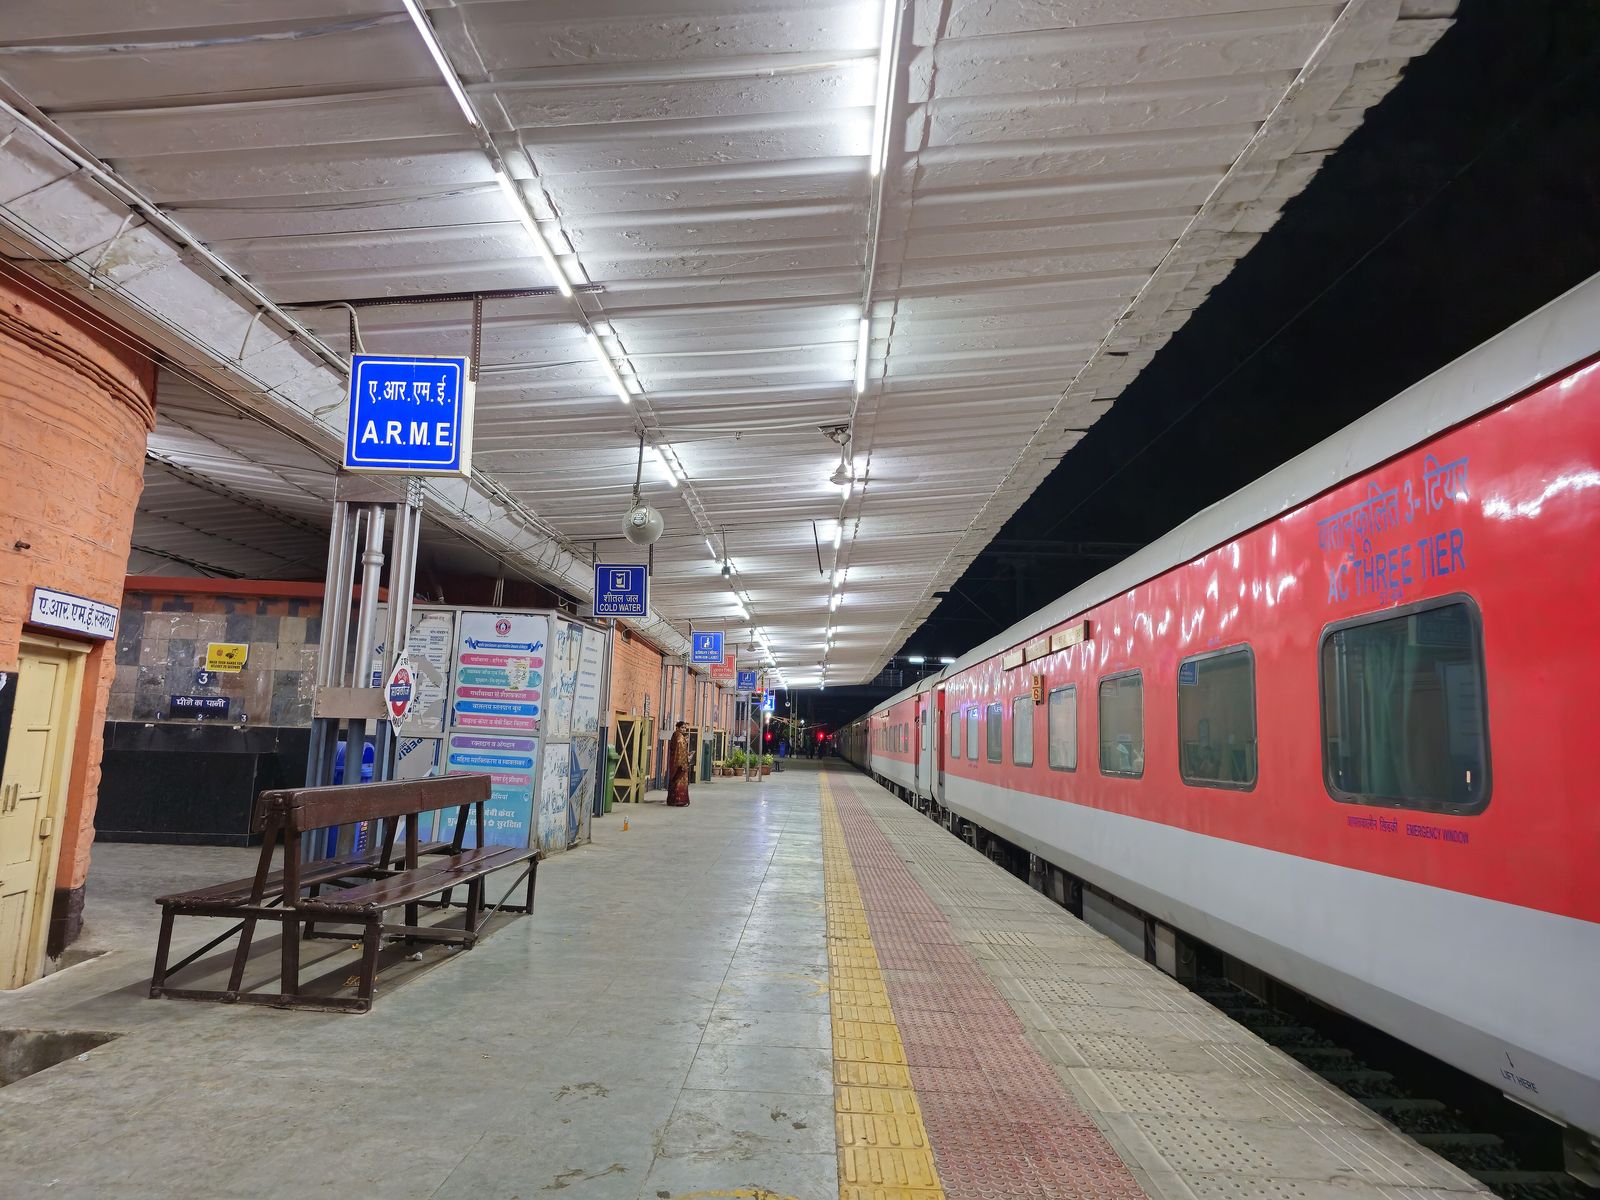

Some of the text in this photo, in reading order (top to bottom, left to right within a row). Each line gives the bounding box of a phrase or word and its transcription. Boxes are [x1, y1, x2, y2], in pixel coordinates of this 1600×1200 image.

[361, 420, 453, 447] A.R.M.E.
[1327, 527, 1466, 605] AC THREE TIER
[603, 591, 639, 602] शीतल जल
[600, 603, 641, 611] COLD WATER
[199, 673, 208, 684] 3
[1033, 688, 1039, 700] 6
[195, 699, 203, 707] का
[206, 699, 226, 708] पानी
[1406, 823, 1469, 844] EMERGENCY WINDOW
[1500, 1068, 1539, 1094] LIFT HERE
